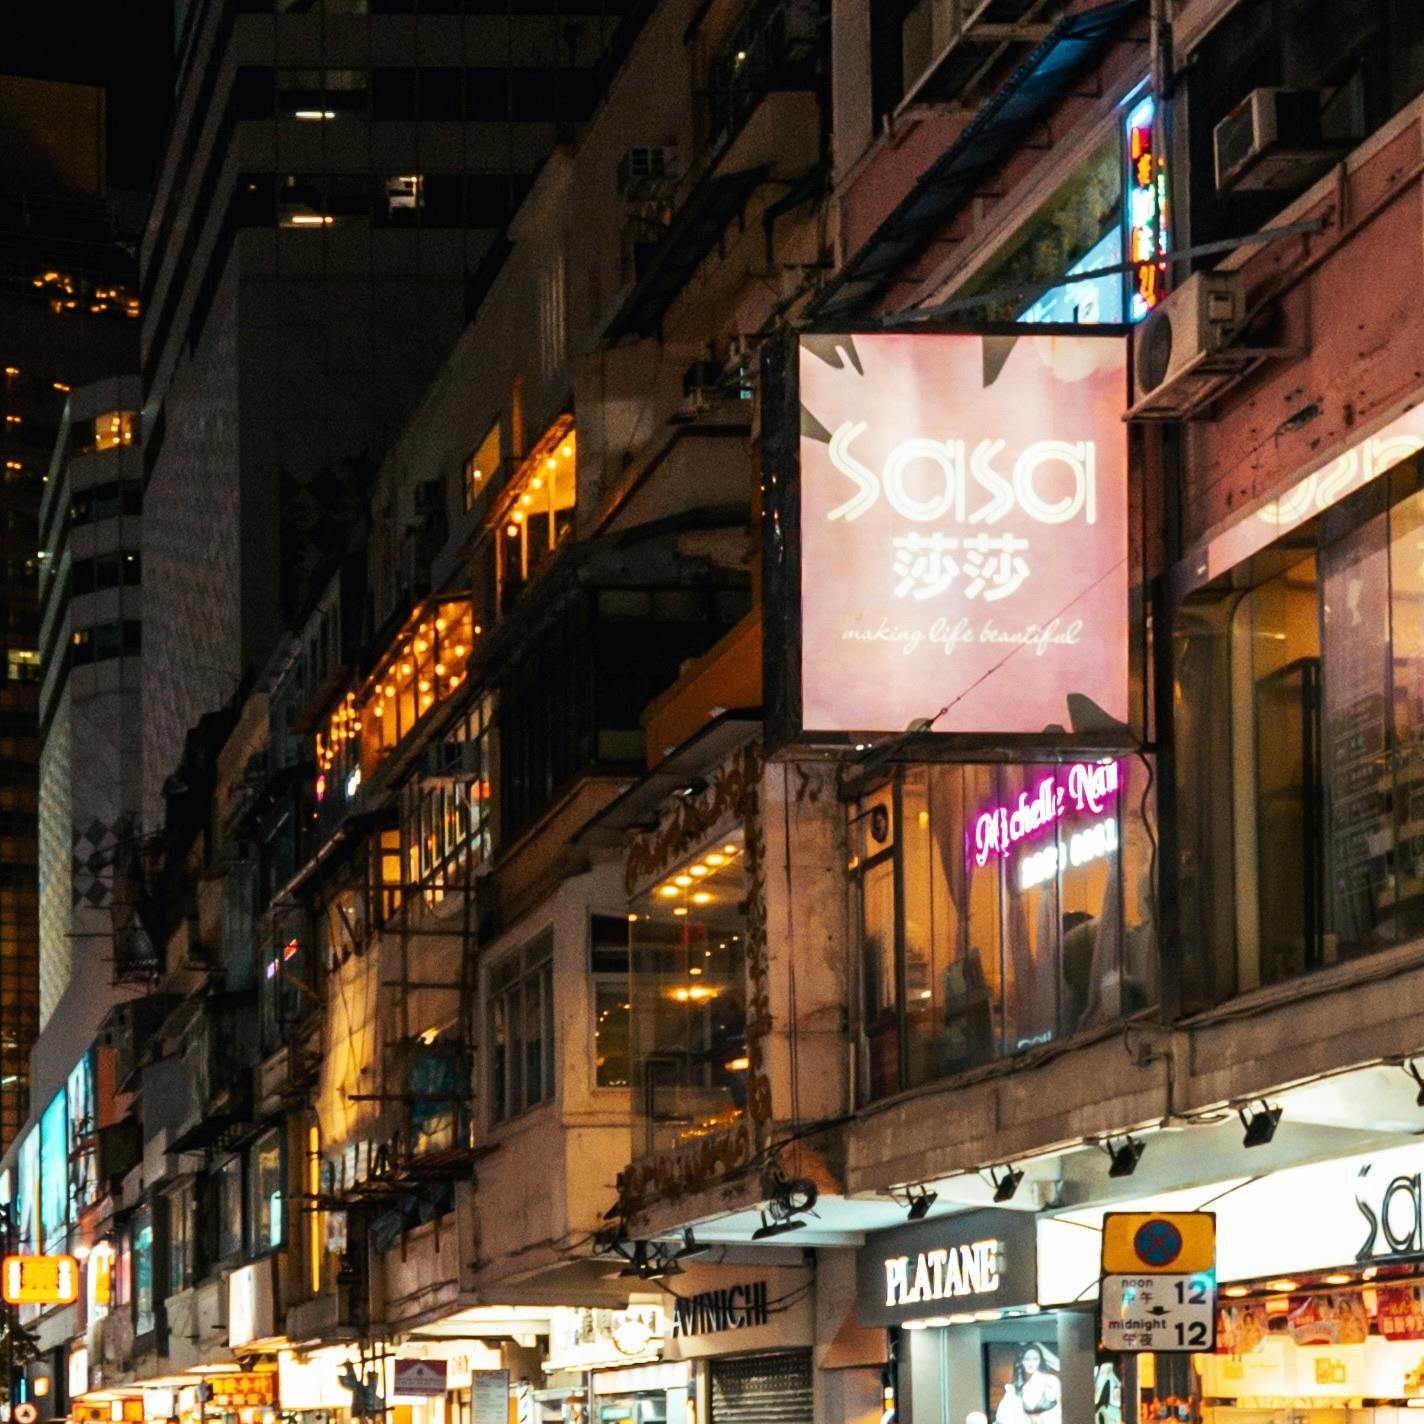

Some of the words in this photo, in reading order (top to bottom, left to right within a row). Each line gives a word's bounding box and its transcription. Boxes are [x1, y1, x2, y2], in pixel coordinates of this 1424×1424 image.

[827, 421, 1097, 525] Sasa
[892, 531, 1031, 602] 莎莎
[841, 617, 926, 656] making
[928, 617, 975, 656] life
[978, 617, 1084, 657] beautiful
[884, 1238, 1000, 1307] PLATANE
[1121, 1278, 1154, 1288] noon
[1174, 1280, 1207, 1305] 12
[1108, 1319, 1167, 1331] midnight
[1174, 1321, 1207, 1346] 12
